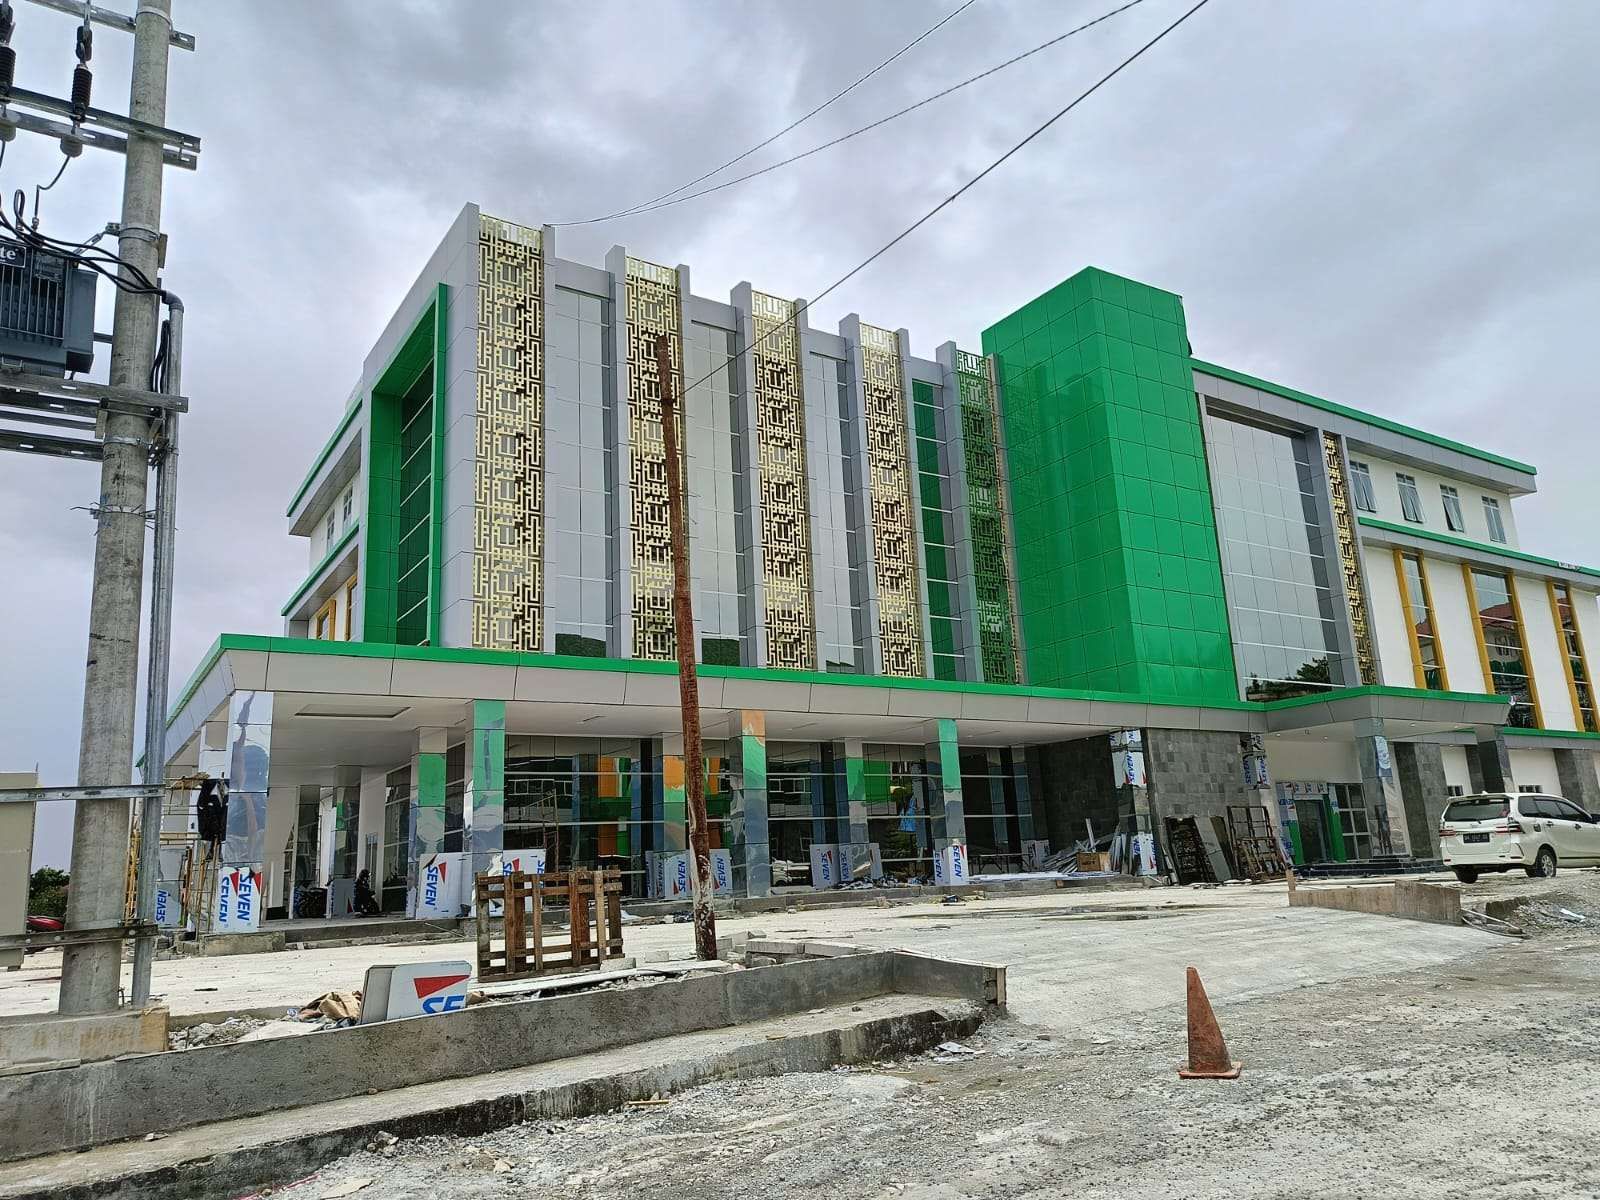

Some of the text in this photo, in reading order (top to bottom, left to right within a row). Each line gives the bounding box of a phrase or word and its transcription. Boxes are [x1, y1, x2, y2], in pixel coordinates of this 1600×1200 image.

[678, 860, 686, 892] SEVEN
[716, 857, 726, 887] SEVEN
[821, 851, 830, 881] SEVEN
[953, 845, 962, 878] SEVEN
[219, 876, 230, 923] SEVEN
[237, 873, 252, 921] SEVEN
[425, 865, 439, 906] SEVEN
[156, 890, 167, 923] SEVEN
